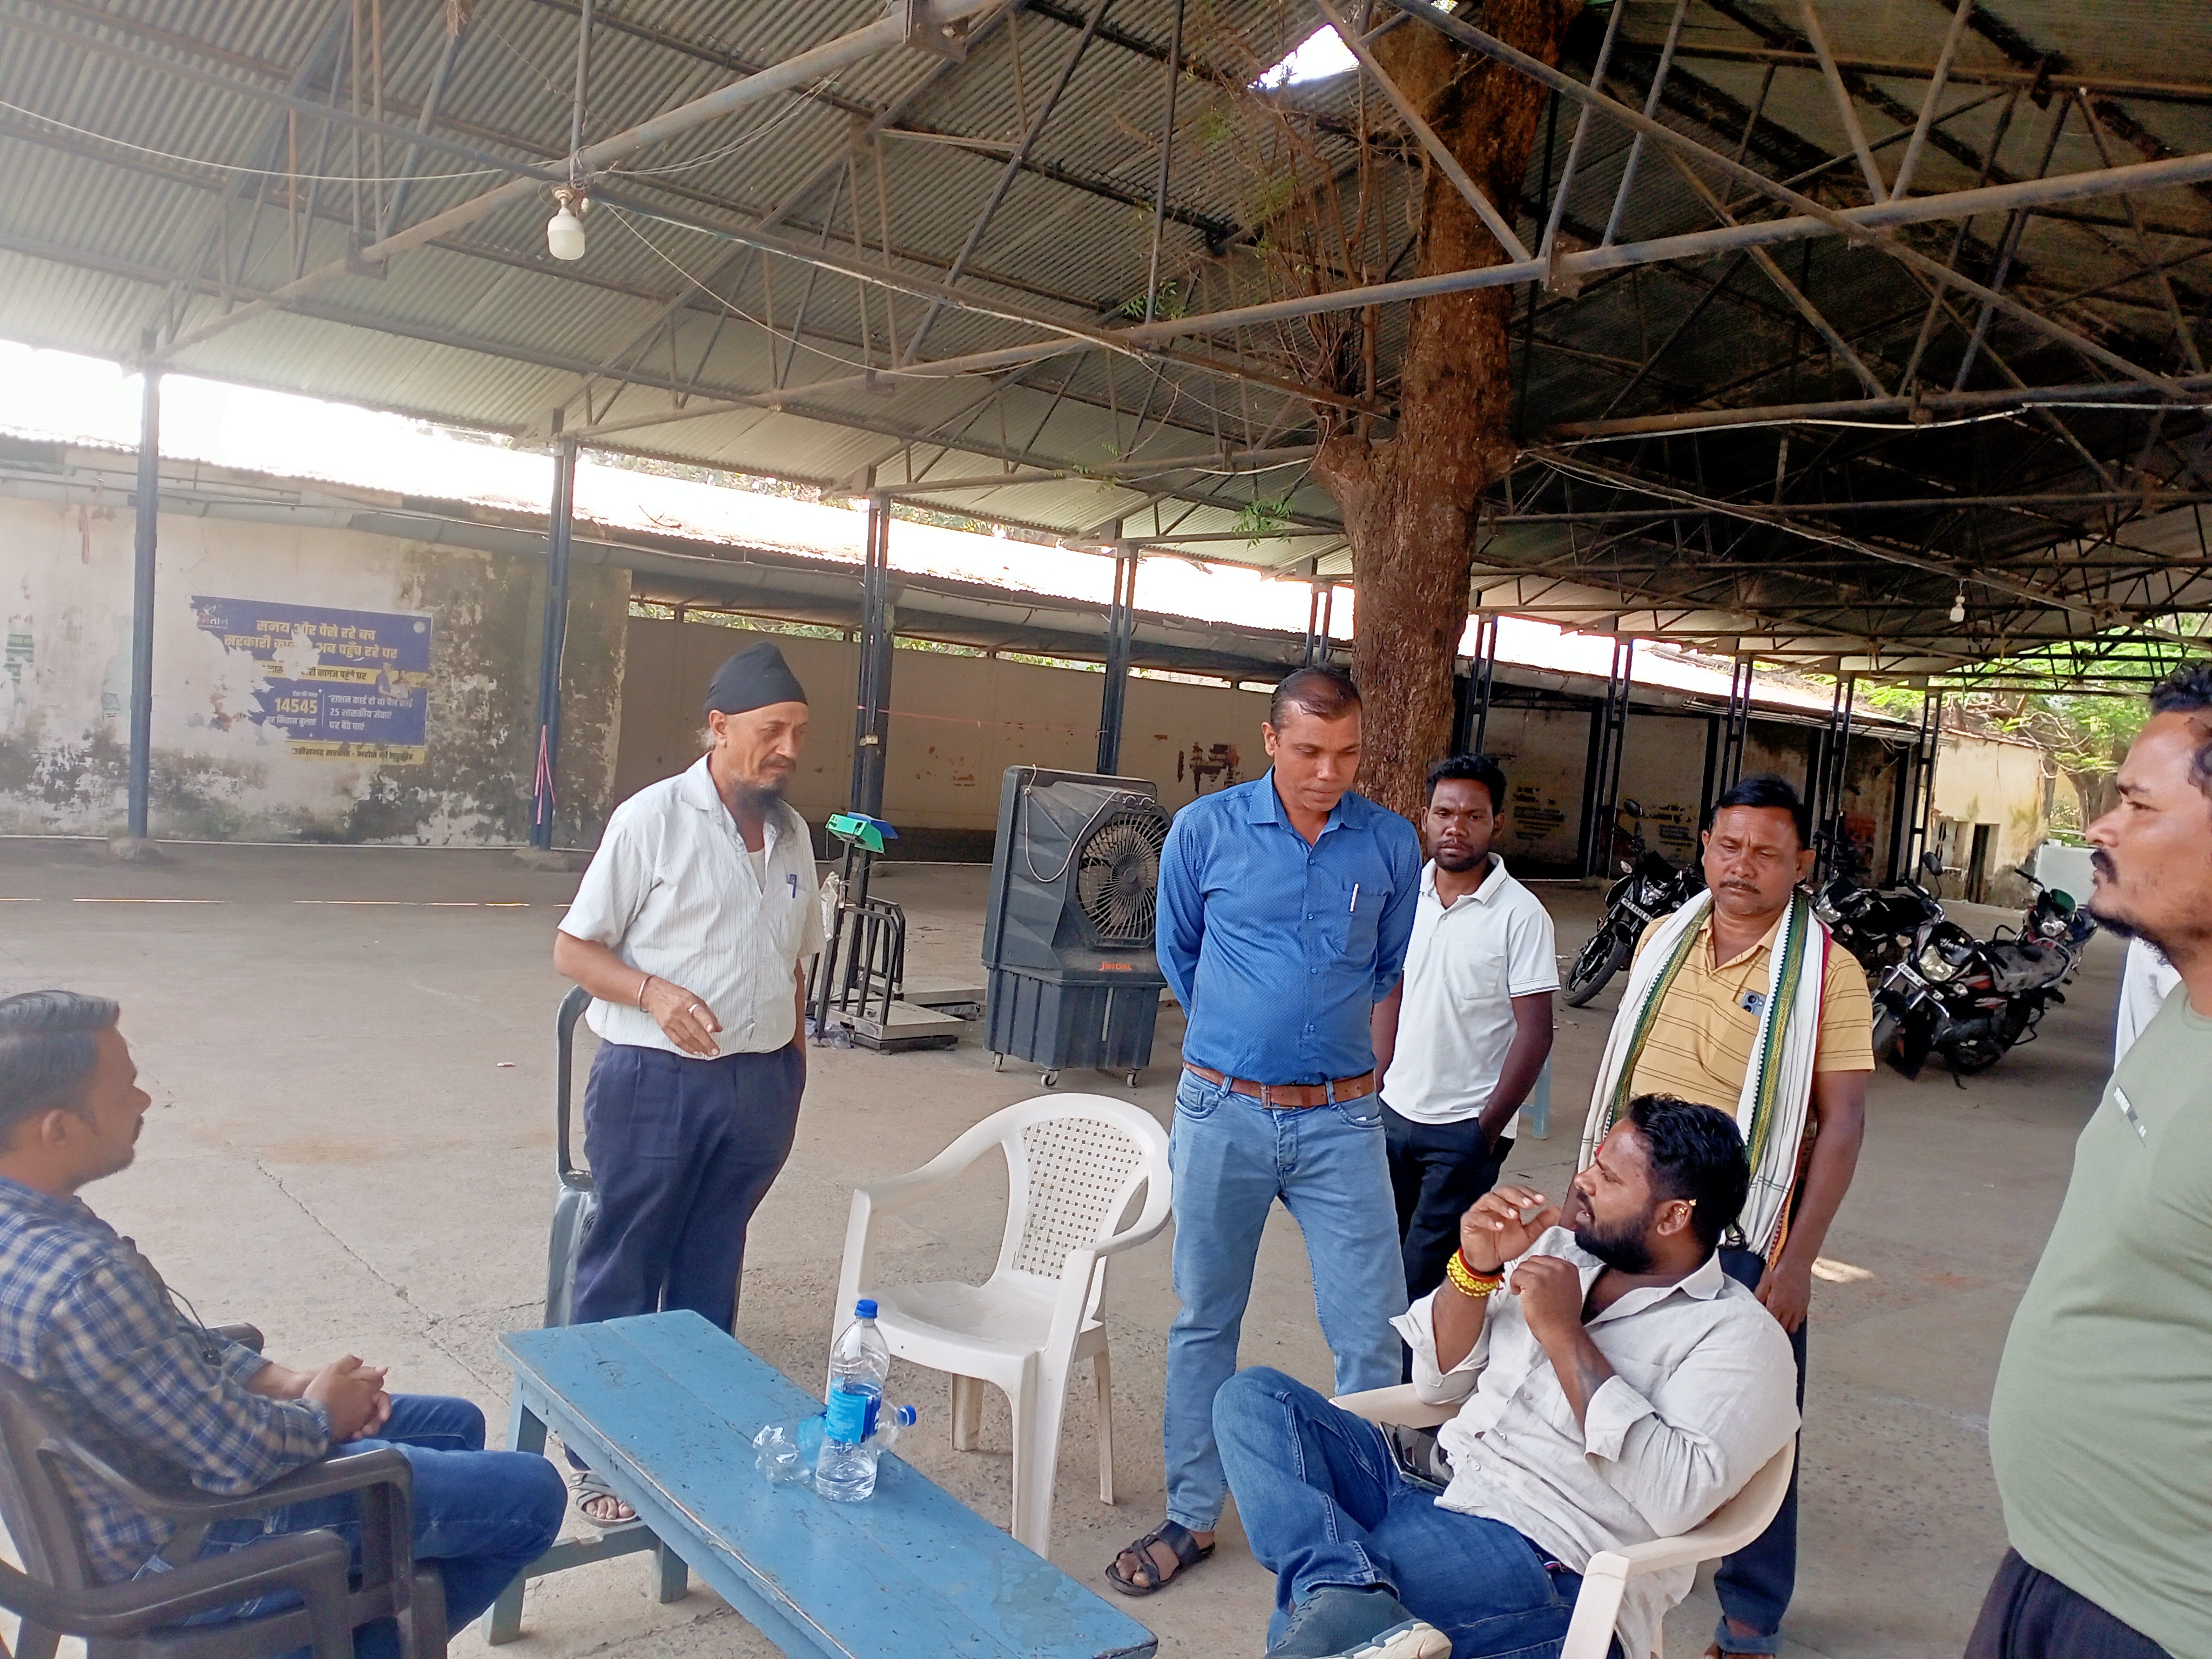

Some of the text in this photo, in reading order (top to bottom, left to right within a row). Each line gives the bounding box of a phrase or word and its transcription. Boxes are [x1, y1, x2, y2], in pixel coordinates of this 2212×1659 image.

[257, 620, 291, 633] समय
[319, 623, 339, 638] पैसे
[341, 626, 356, 639] रहे
[224, 635, 271, 648] सरकारी
[316, 643, 336, 654] अब
[364, 644, 380, 657] रहे
[318, 669, 339, 678] कागज
[328, 695, 351, 703] राशन
[353, 695, 367, 704] कार्ड
[368, 696, 376, 705] हो
[275, 698, 318, 714] 14545
[330, 708, 340, 716] 25
[342, 708, 372, 718] शासकीय
[1099, 961, 1132, 971] JINDAL
